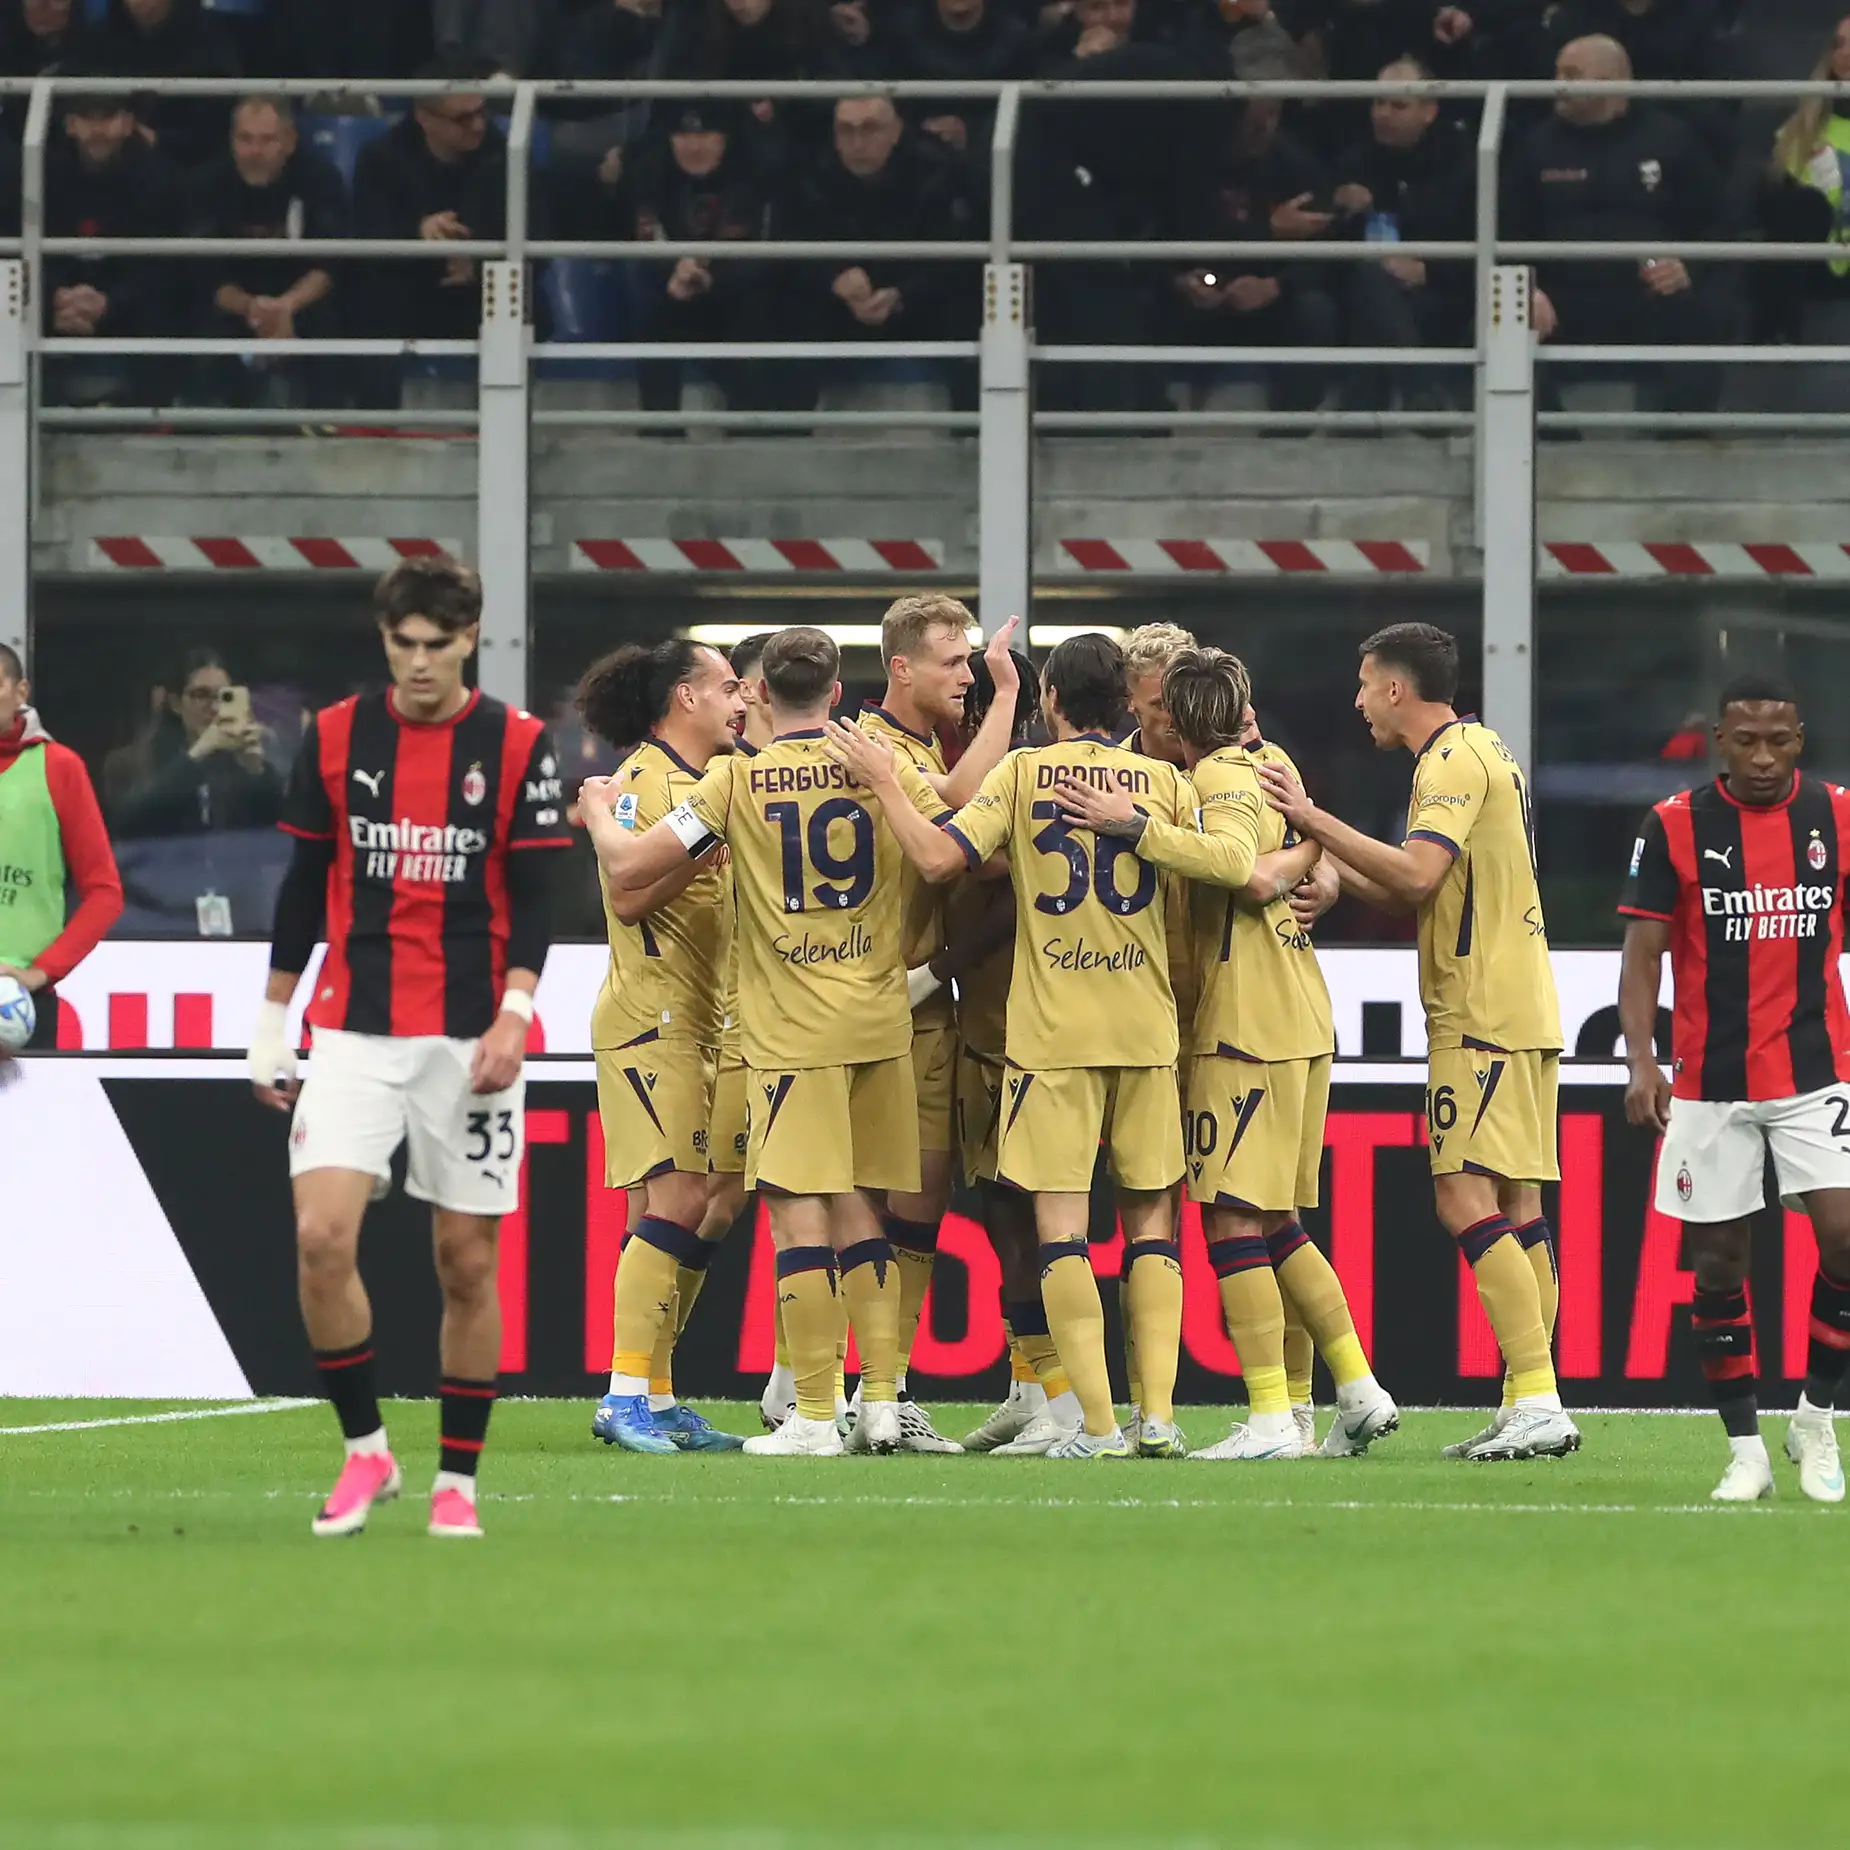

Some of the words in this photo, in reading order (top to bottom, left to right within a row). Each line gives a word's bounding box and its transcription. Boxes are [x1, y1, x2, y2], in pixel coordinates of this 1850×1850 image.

[751, 764, 859, 794] FERGUSO
[349, 815, 488, 854] Emirates
[366, 851, 400, 879] FLY
[401, 853, 468, 882] BETTER
[765, 797, 875, 914] 19
[1701, 882, 1833, 916] Emirates
[772, 924, 872, 965] Selenella
[1725, 917, 1754, 942] FLY
[1757, 913, 1817, 940] BETTER
[1042, 937, 1146, 972] Selenella
[1427, 1085, 1457, 1133] 16
[467, 1110, 515, 1162] 33
[1186, 1109, 1218, 1156] 10
